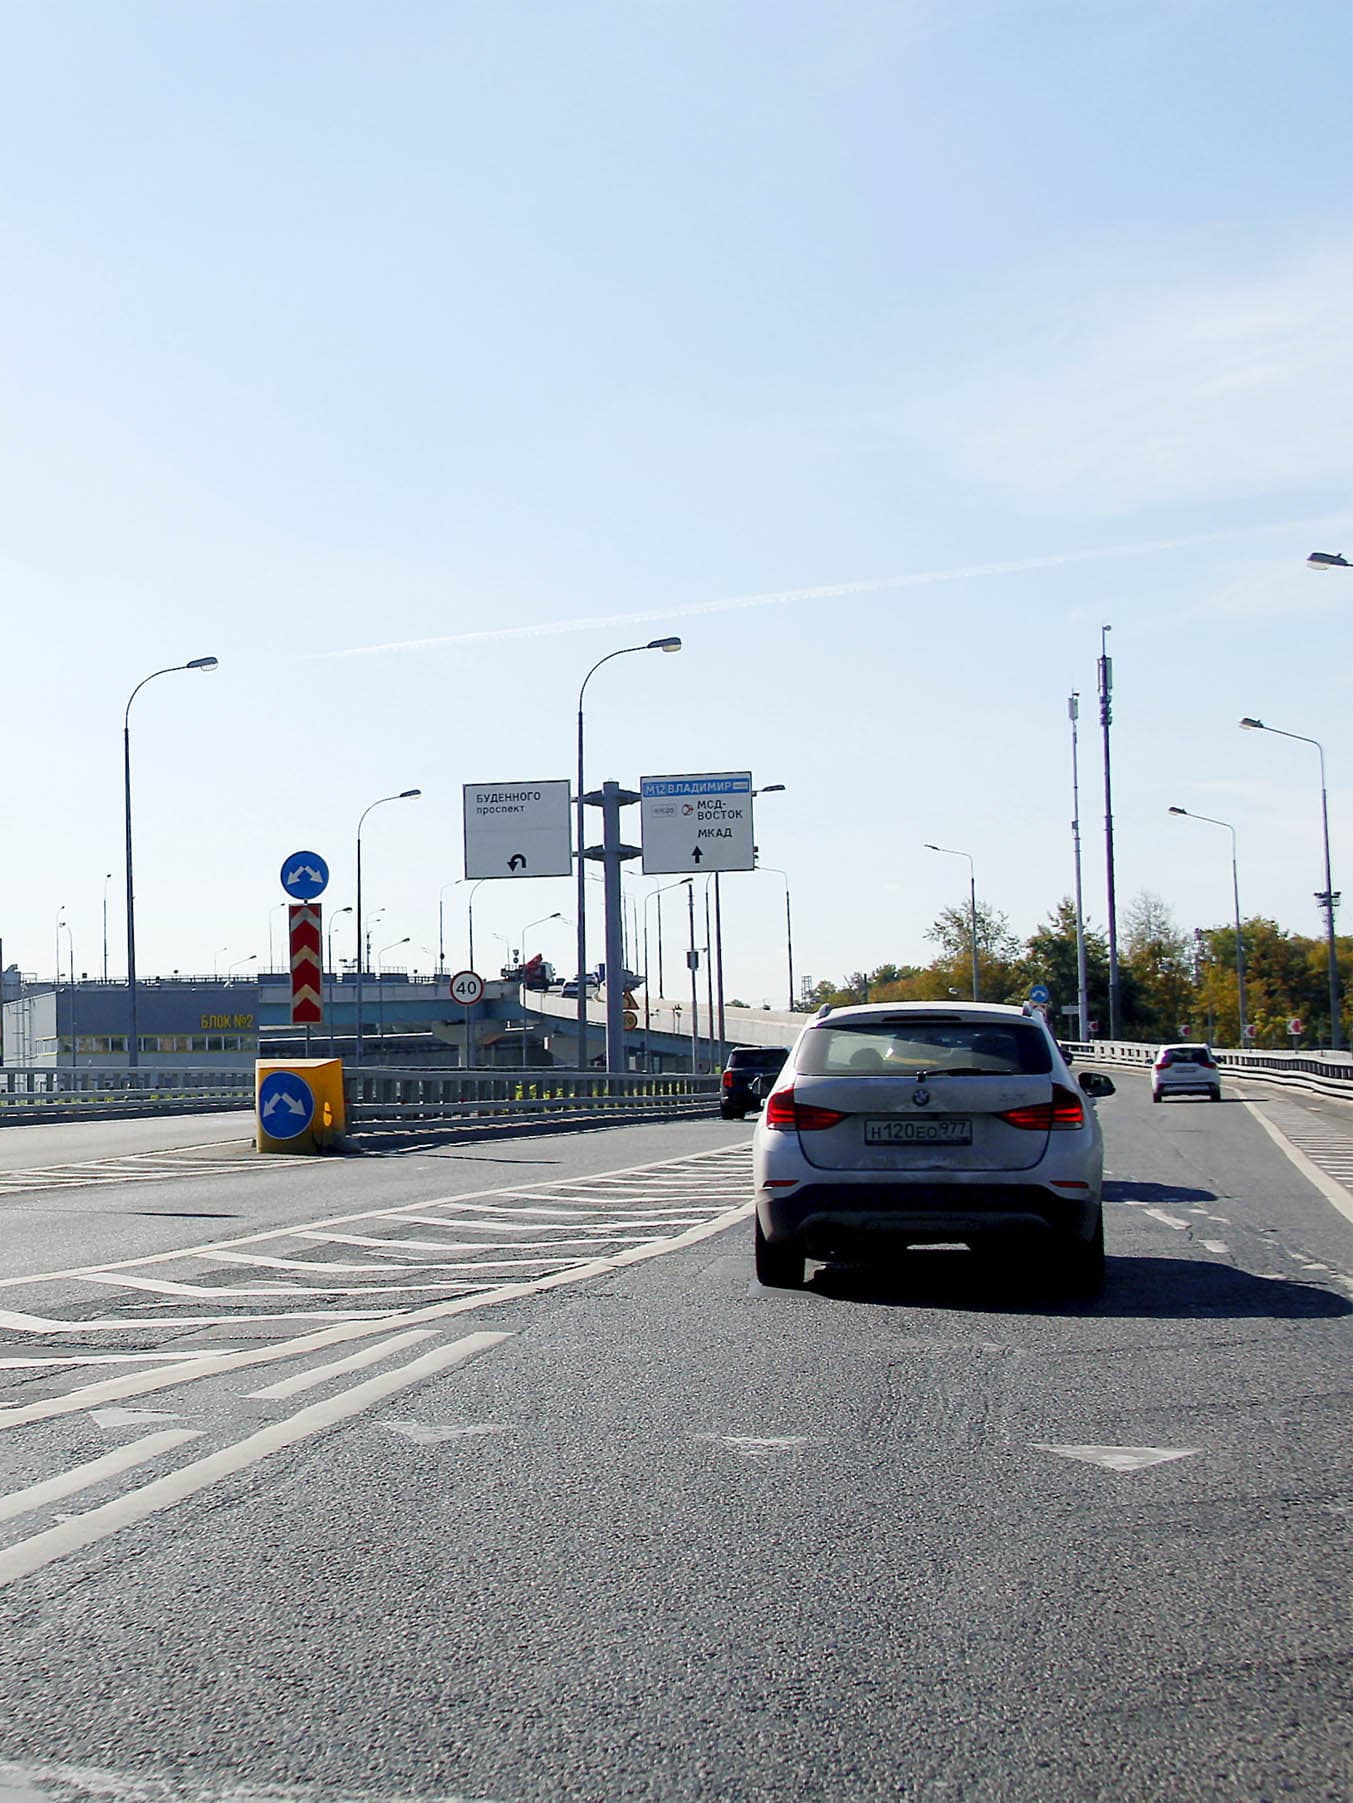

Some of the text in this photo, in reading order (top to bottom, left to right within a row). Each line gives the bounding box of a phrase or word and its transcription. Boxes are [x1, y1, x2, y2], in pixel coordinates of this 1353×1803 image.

[668, 781, 732, 794] ВЛАДИМИР
[476, 791, 541, 803] БУДЕННОГО
[476, 805, 525, 816] проспект
[697, 800, 727, 810] МСД-
[697, 809, 743, 821] ВОСТОК
[697, 827, 733, 838] МКАД
[456, 981, 477, 995] 40
[200, 1014, 231, 1029] БЛОК
